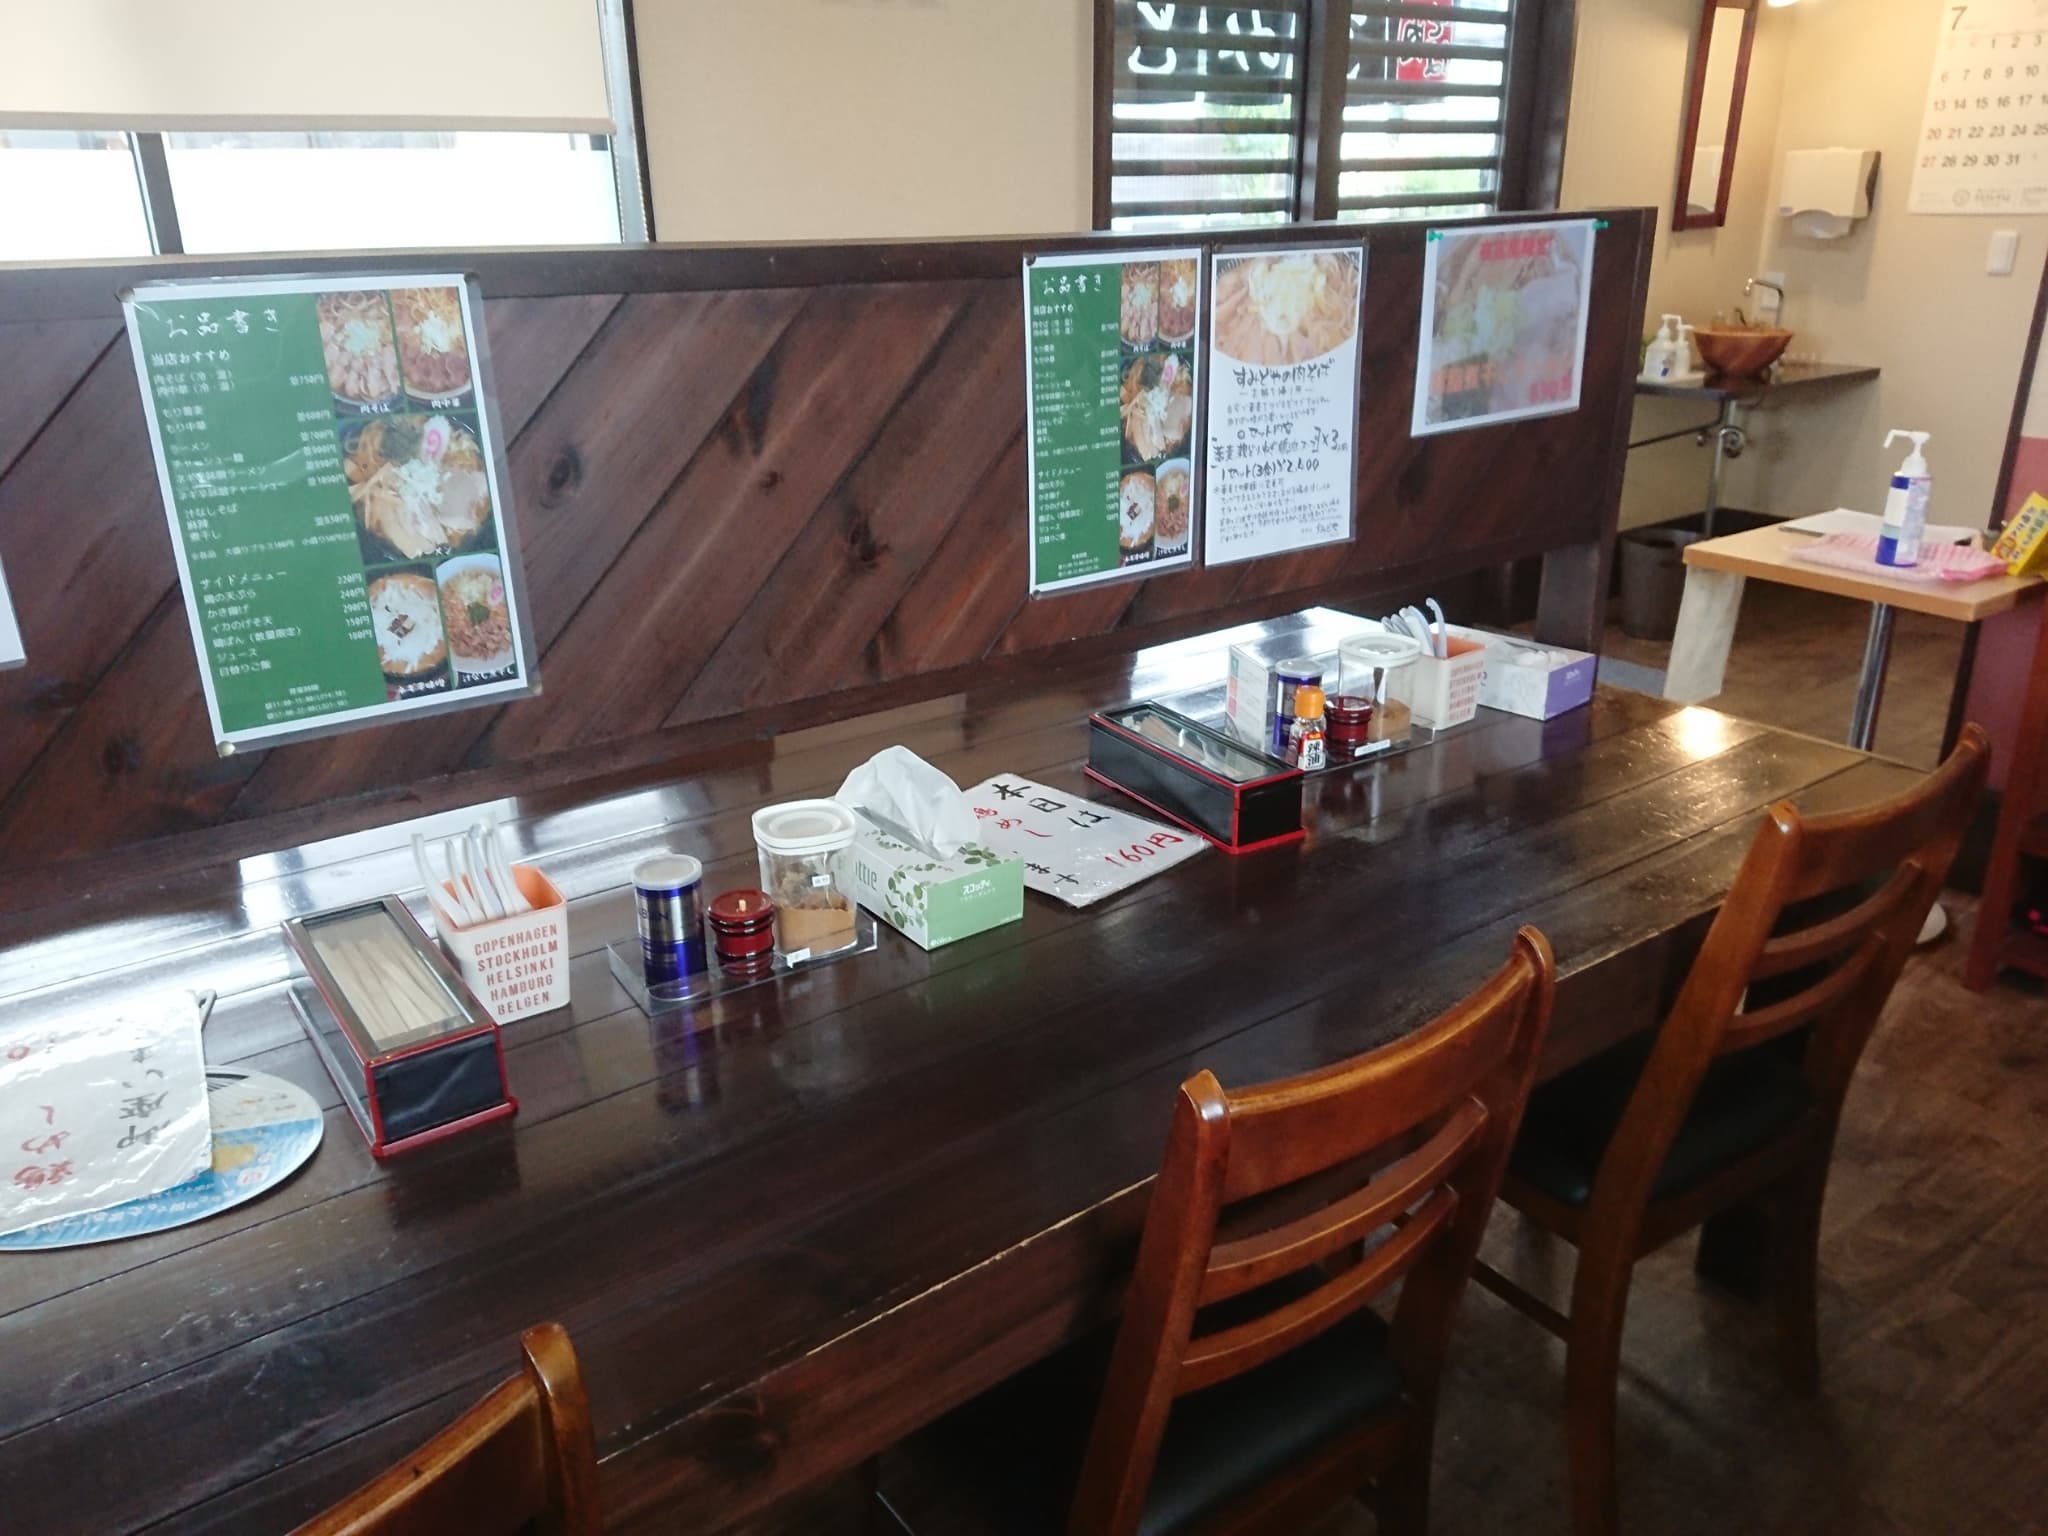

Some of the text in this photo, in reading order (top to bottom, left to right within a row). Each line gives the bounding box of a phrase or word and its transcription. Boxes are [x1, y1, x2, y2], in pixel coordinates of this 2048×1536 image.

[1952, 6, 1968, 31] 7
[1975, 96, 1989, 110] 15
[1997, 95, 2011, 109] 16
[2019, 94, 2033, 107] 17
[1967, 126, 1984, 139] 22
[1988, 125, 2006, 138] 23
[2010, 124, 2028, 137] 24
[1961, 154, 1979, 168] 29
[1983, 153, 2000, 167] 30
[2004, 152, 2021, 166] 31
[1043, 273, 1101, 295] お品書き
[166, 308, 279, 338] お品書き
[151, 349, 231, 367] 当店おすすめ
[200, 571, 288, 590] サイドメニュー
[992, 783, 1111, 829] 本日は
[1104, 832, 1185, 868] 160円
[474, 923, 558, 957] COPENHAGEN
[477, 939, 559, 973] STOCKHOLM
[486, 957, 554, 987] HELSINKI
[490, 974, 553, 1002] HAMBURG
